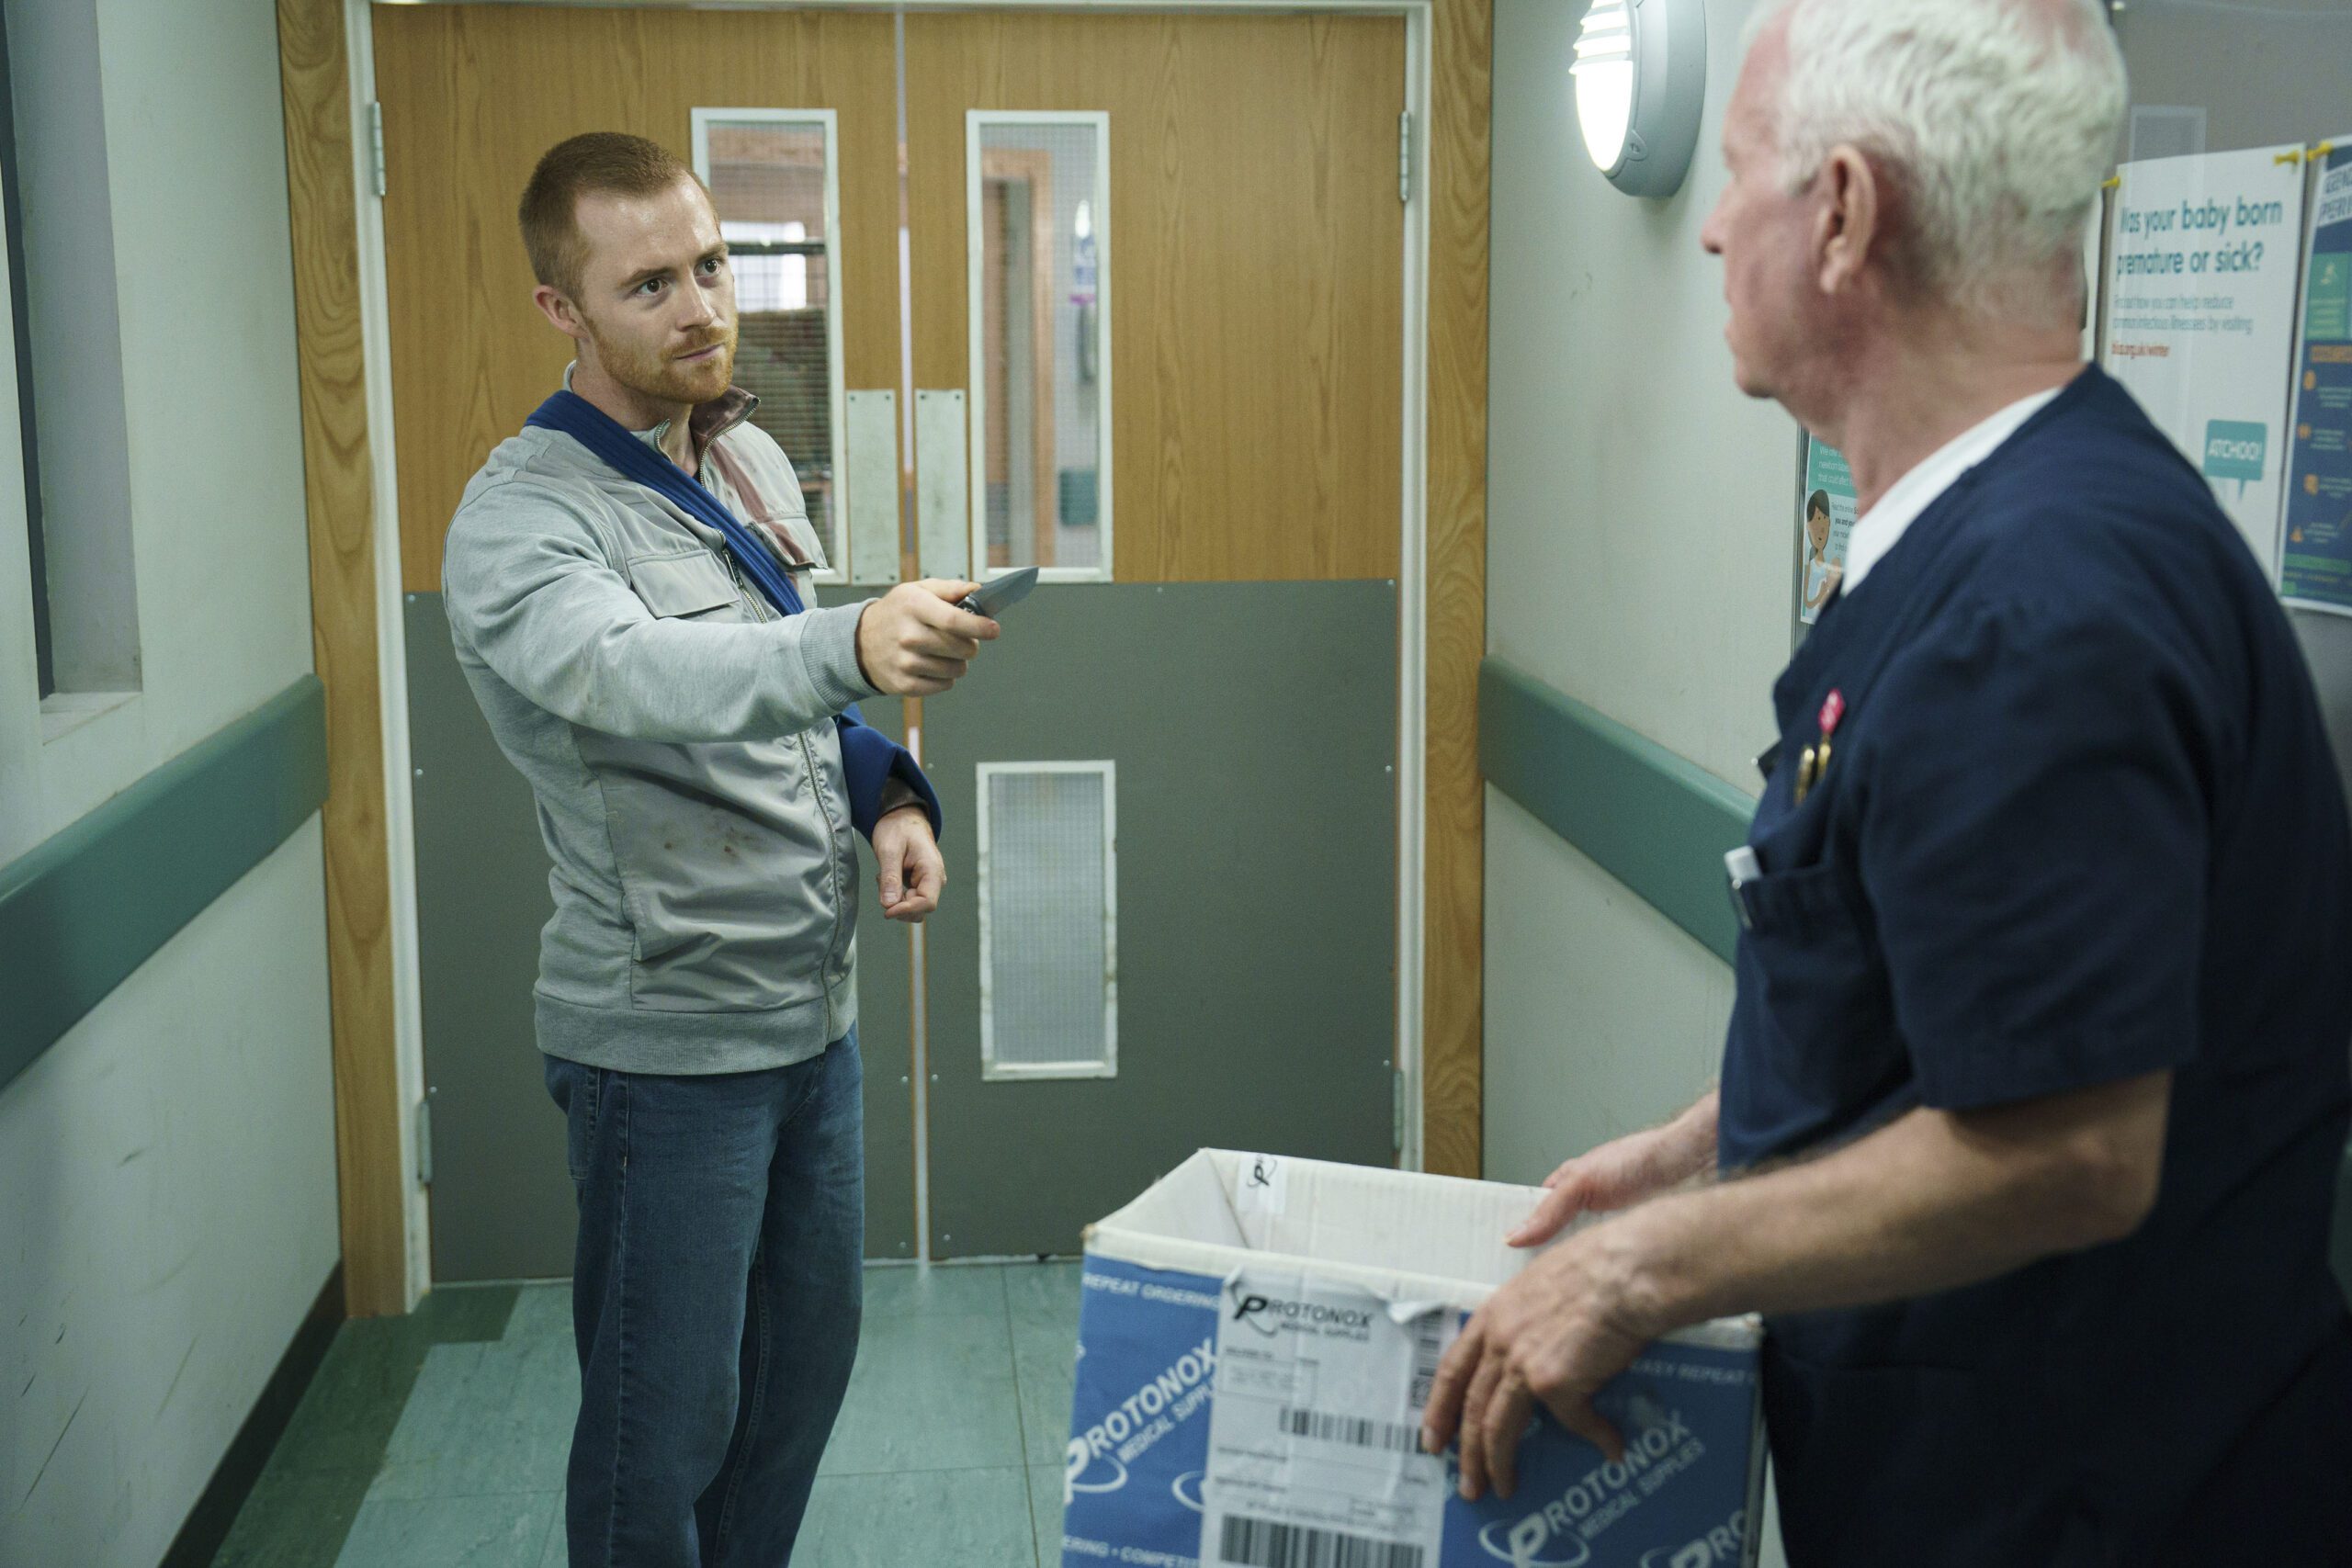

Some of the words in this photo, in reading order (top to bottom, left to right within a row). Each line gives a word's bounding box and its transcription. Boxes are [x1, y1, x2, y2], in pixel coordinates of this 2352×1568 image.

[2144, 209, 2176, 241] your
[2182, 199, 2231, 236] baby
[2236, 196, 2283, 227] born
[2116, 250, 2184, 281] premature
[2190, 251, 2209, 273] or
[2215, 241, 2264, 272] sick?
[1082, 1273, 1139, 1297] REPEAT
[1141, 1283, 1219, 1311] ORDERING
[1233, 1295, 1374, 1328] PROTONOX
[1062, 1337, 1219, 1506] PROTONOX
[1116, 1414, 1175, 1464] MEDICAL
[1508, 1408, 1691, 1568] PROTONOX
[1577, 1488, 1642, 1539] MEDICAL
